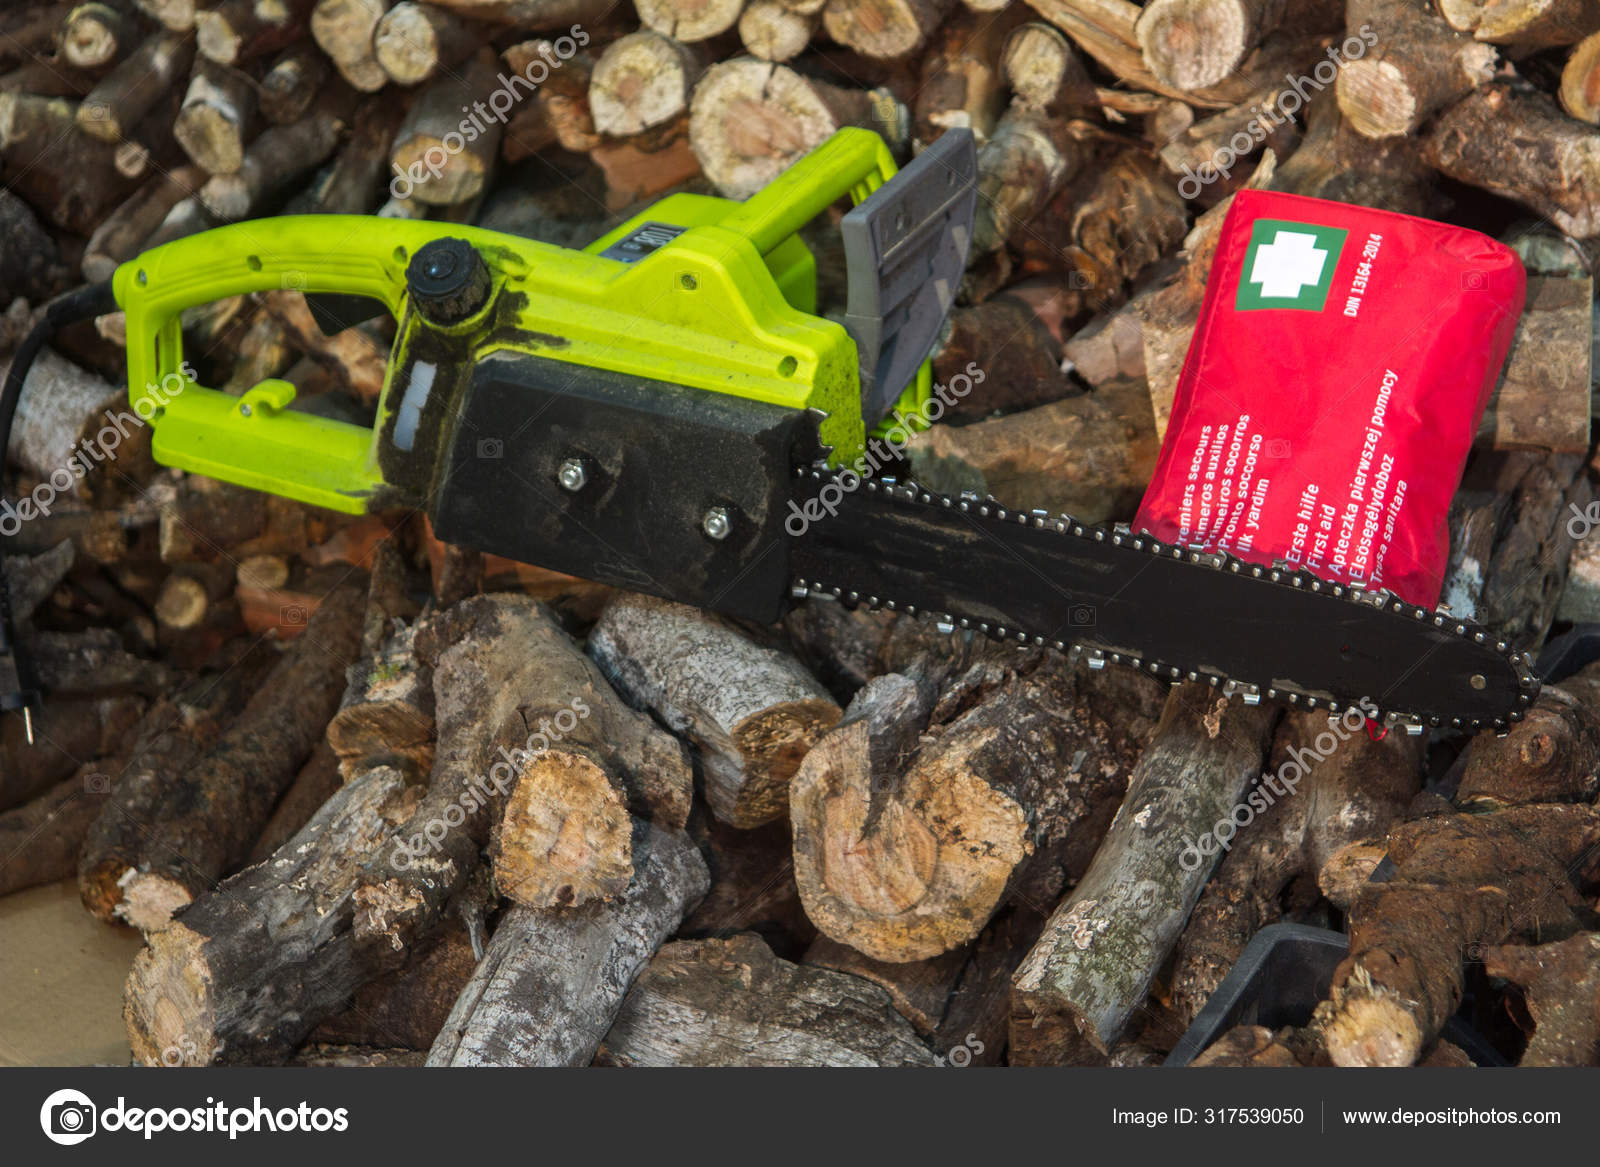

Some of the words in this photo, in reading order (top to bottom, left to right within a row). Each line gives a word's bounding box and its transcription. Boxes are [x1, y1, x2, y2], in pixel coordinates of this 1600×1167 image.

[1350, 233, 1383, 295] 13164-2014
[1343, 295, 1362, 318] DIN
[1188, 425, 1212, 481] secours
[1194, 483, 1213, 541] rimeros
[1205, 424, 1229, 481] auxilios
[1203, 478, 1232, 548] Primeiros
[1224, 414, 1250, 476] socorros
[1328, 502, 1359, 576] Apteczka
[1349, 426, 1383, 502] pierwszej
[1371, 368, 1399, 428] pomocy
[1217, 502, 1245, 549] Pronto
[1238, 434, 1263, 499] soccorso
[1246, 478, 1270, 530] yardim
[1285, 522, 1309, 563] Erste
[1297, 483, 1319, 520] hilfe
[1306, 529, 1329, 569] First
[1319, 503, 1336, 531] aid
[1369, 543, 1388, 584] Trusa
